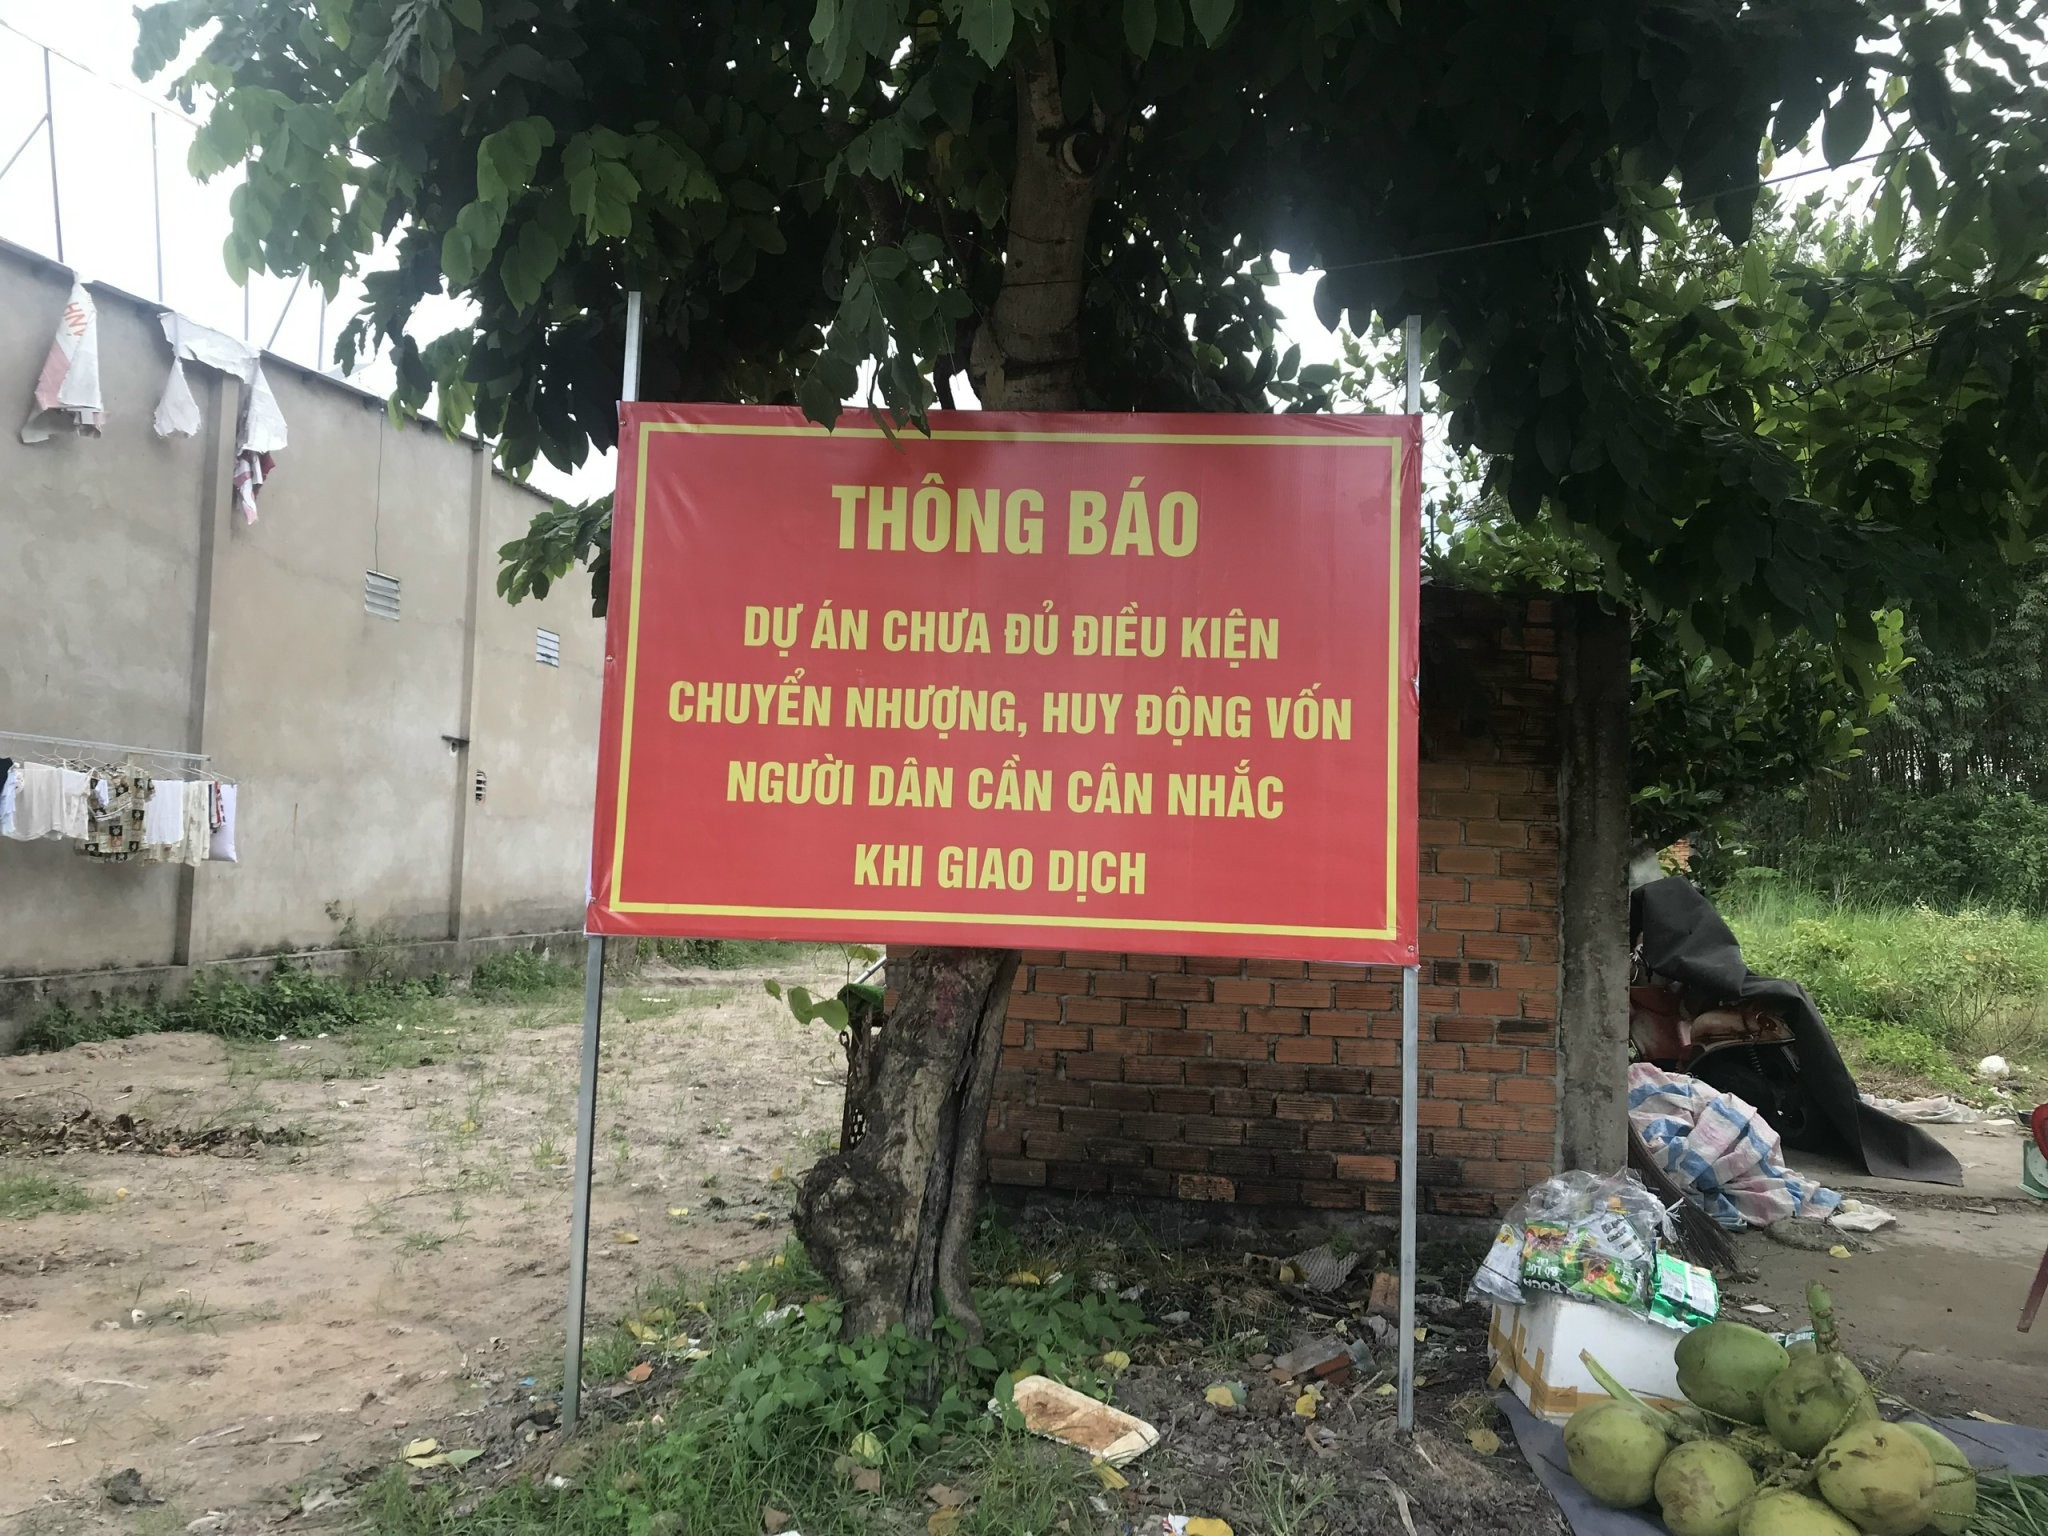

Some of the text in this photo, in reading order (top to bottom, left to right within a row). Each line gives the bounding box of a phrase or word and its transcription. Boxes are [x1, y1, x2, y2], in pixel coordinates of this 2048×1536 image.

[831, 472, 1199, 558] THÔNG BÁO
[744, 600, 1280, 669] DỰ ÁN CHƯA ĐỦ ĐIỀU KIỆN
[669, 668, 1353, 747] CHUYỂN NHƯỢNG, HUY ĐỘNG VỐN
[727, 753, 1285, 820] NGƯỜI DÂN CẦN CÂN NHẮC
[854, 844, 1147, 904] KHI GIAO DỊCH
